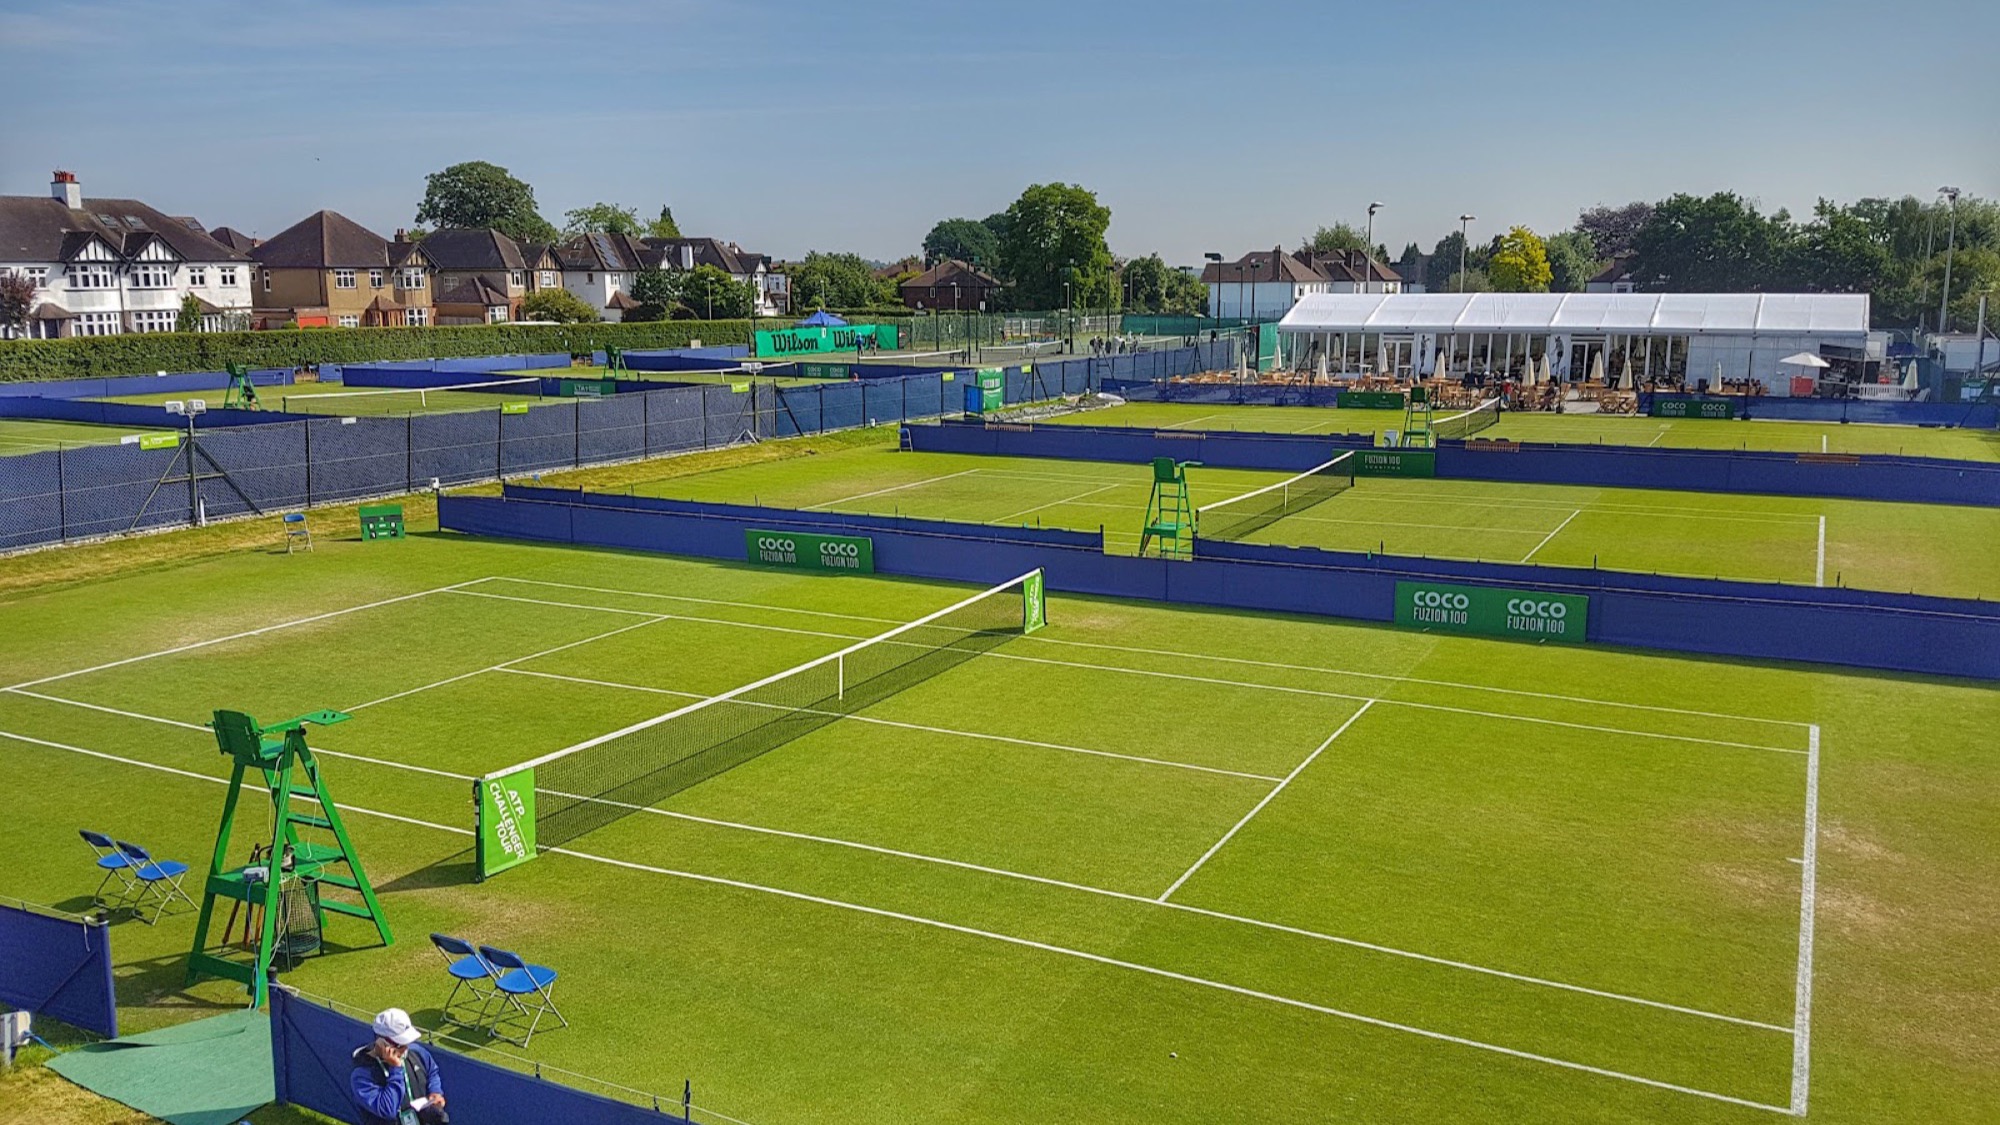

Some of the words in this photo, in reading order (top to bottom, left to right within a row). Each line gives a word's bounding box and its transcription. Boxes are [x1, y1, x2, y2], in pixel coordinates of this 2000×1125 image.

[771, 332, 819, 352] Wilson
[1662, 401, 1686, 410] COCO
[1701, 403, 1726, 411] COCO
[1389, 455, 1400, 465] 100
[758, 537, 795, 552] COCO
[819, 542, 858, 557] COCO
[760, 550, 783, 563] FUZION
[784, 551, 797, 563] 100
[821, 555, 846, 568] FUZION
[846, 557, 859, 568] 100
[1413, 590, 1470, 610] COCO
[1507, 598, 1567, 619] COCO
[1413, 606, 1448, 623] FUZION
[1450, 610, 1468, 625] 100
[1507, 615, 1545, 633] FUZION
[1545, 619, 1565, 634] 100
[489, 782, 526, 861] CHALLENGER
[494, 820, 513, 855] TOUR
